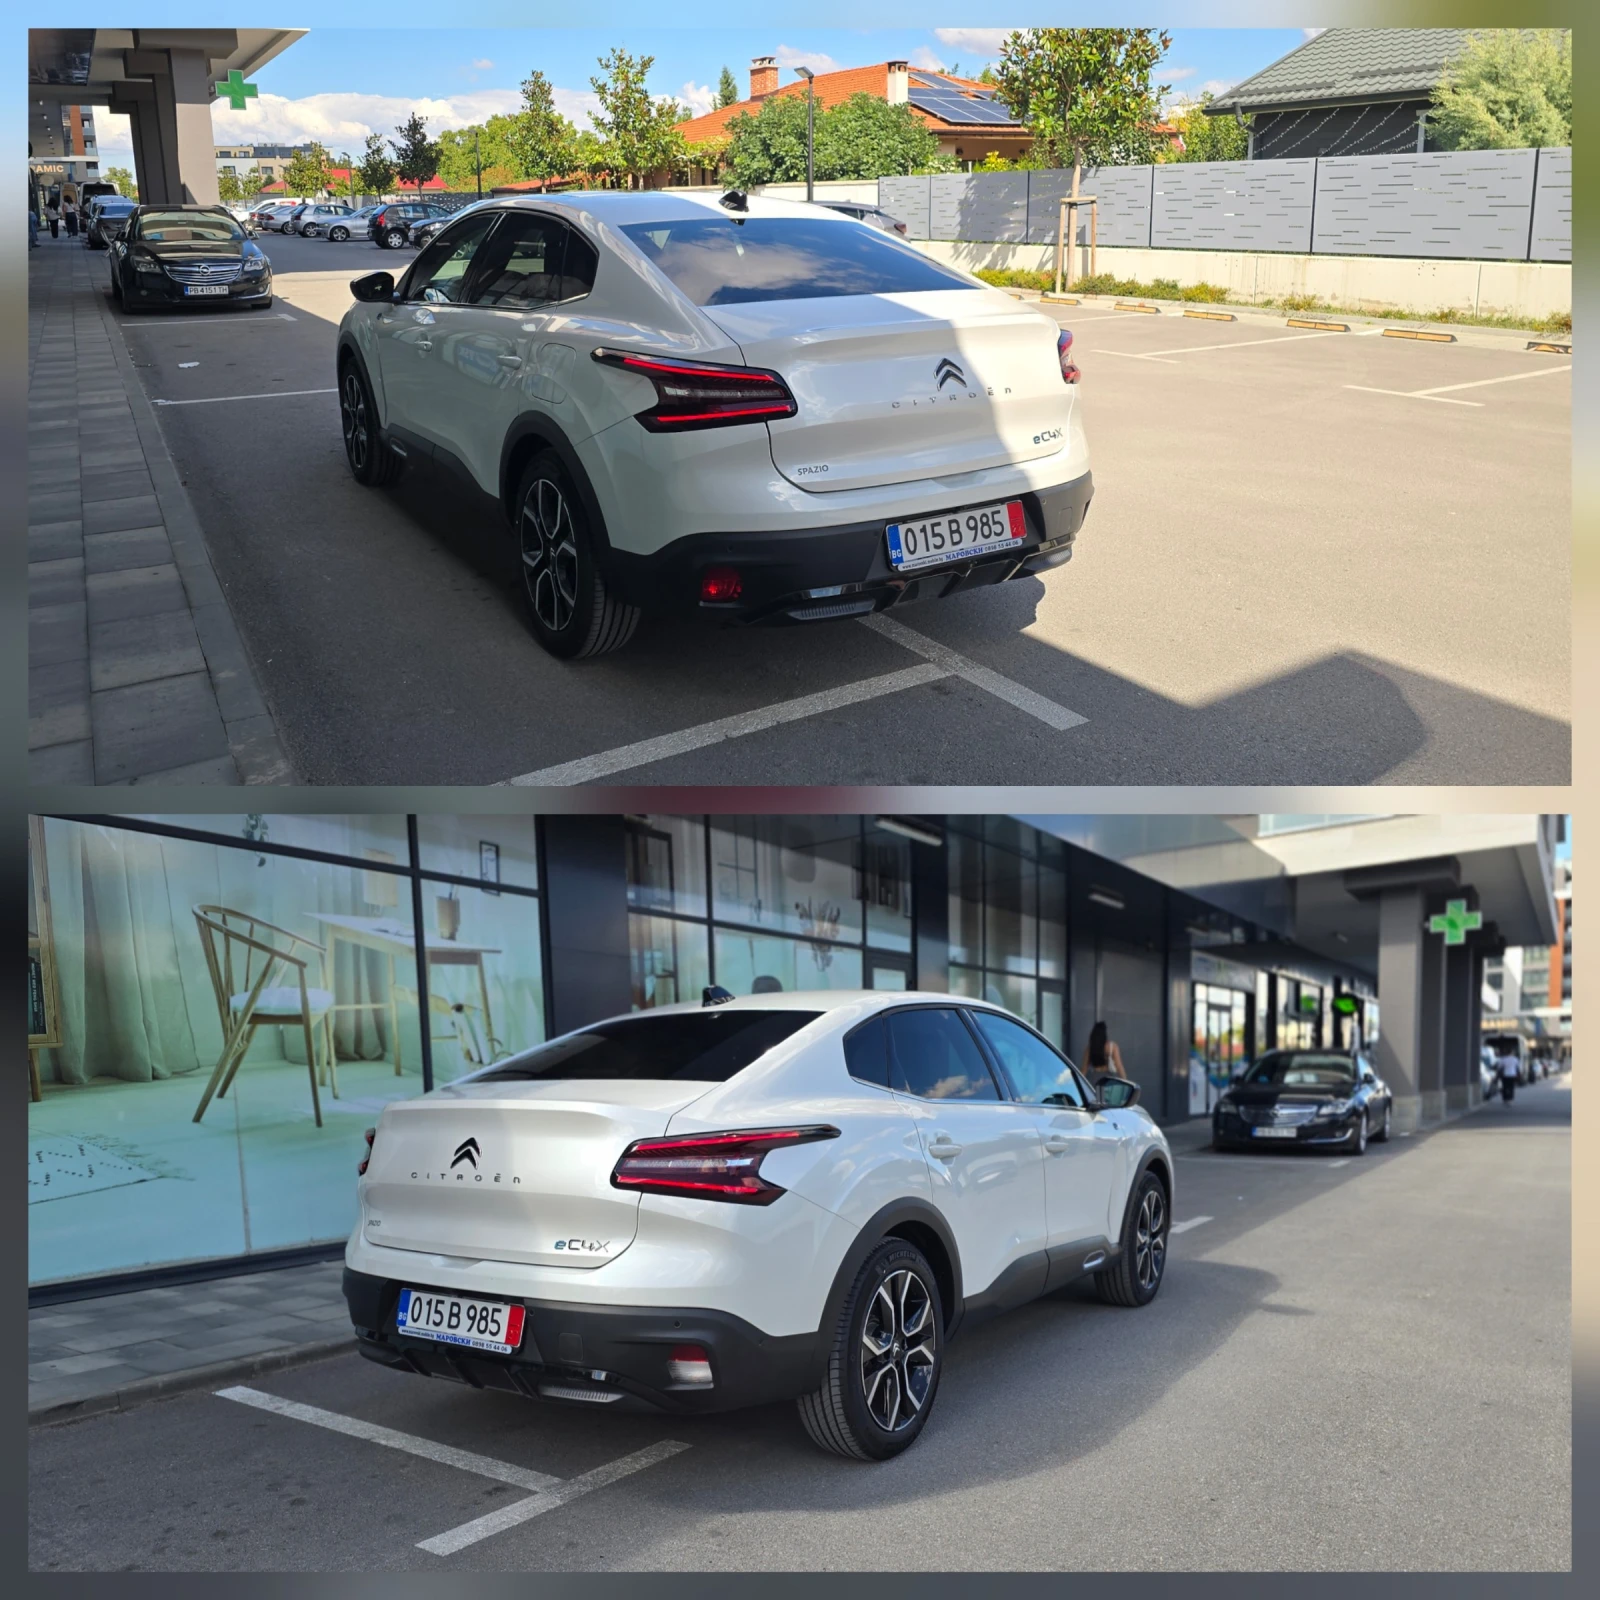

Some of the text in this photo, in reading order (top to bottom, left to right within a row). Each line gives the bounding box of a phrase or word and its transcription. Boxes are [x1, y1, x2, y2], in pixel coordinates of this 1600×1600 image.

[797, 464, 829, 476] SPAZIO
[891, 549, 902, 559] BG
[945, 546, 984, 561] МАРОВСКИ
[889, 1250, 917, 1262] MICHELIN
[398, 1311, 408, 1321] BG
[435, 1333, 471, 1346] МАРОВСКИ
